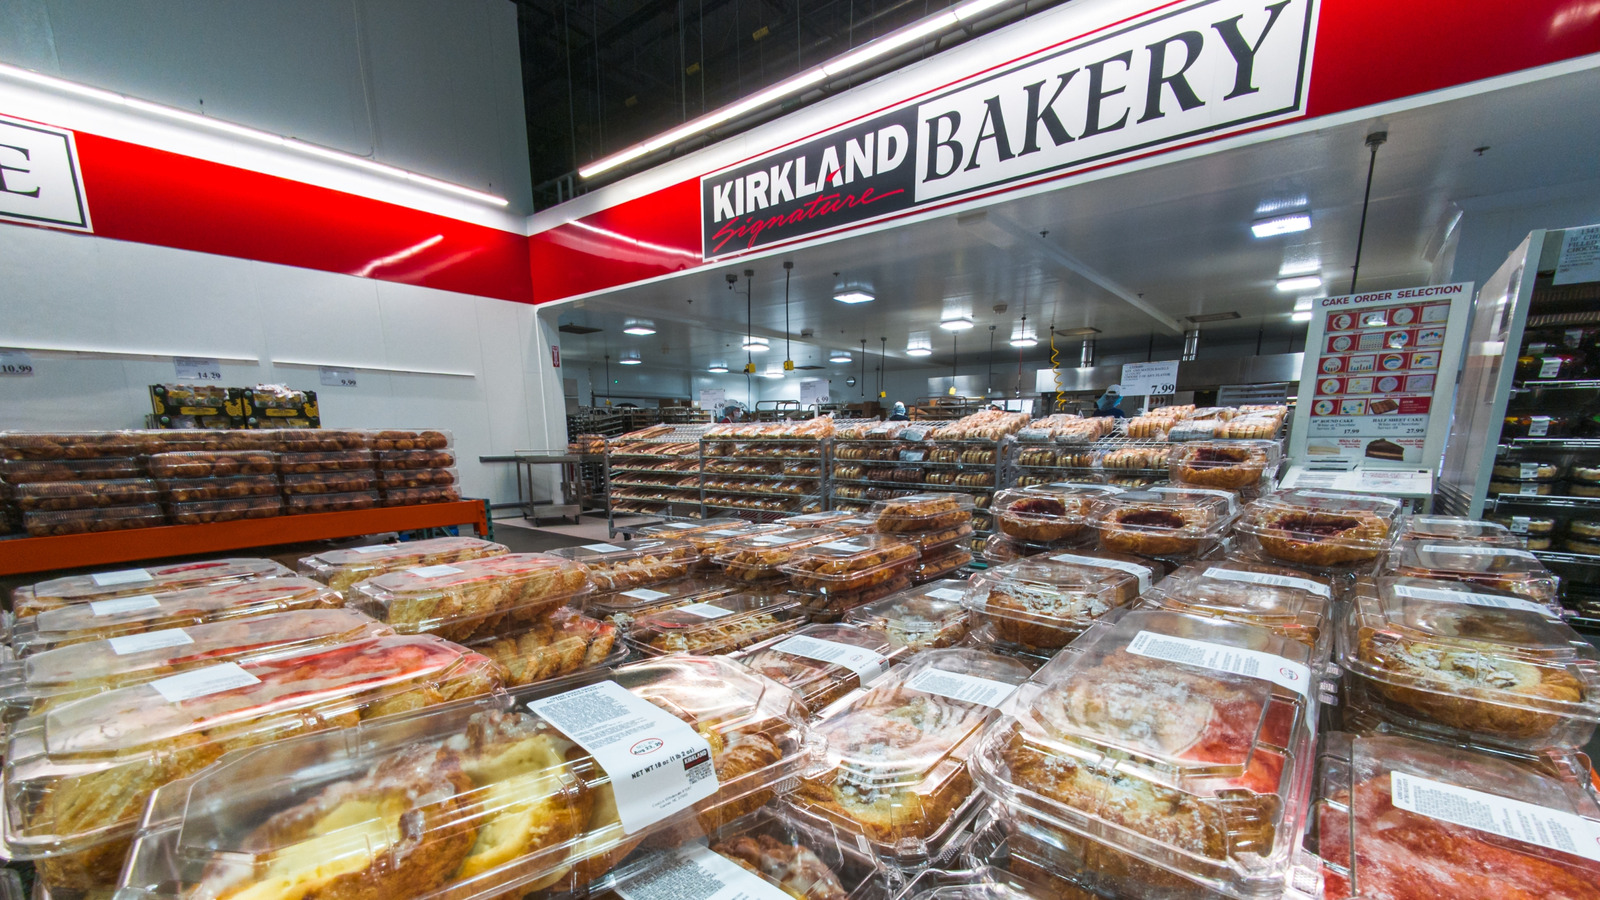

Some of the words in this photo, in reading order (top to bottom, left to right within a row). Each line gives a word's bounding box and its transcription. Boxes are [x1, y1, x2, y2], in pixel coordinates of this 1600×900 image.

[922, 0, 1292, 184] BAKERY
[711, 124, 909, 223] KIRKLAND
[711, 187, 905, 253] Signature
[1321, 296, 1350, 307] CAKE
[1354, 292, 1392, 303] ORDER
[1397, 285, 1463, 299] SELECTION
[2, 364, 33, 373] 10.99
[1151, 384, 1175, 394] 7.99
[631, 769, 644, 780] NET
[644, 765, 654, 774] WT
[670, 755, 676, 763] (1
[687, 747, 695, 756] oz)
[684, 750, 708, 765] KIRKLAND
